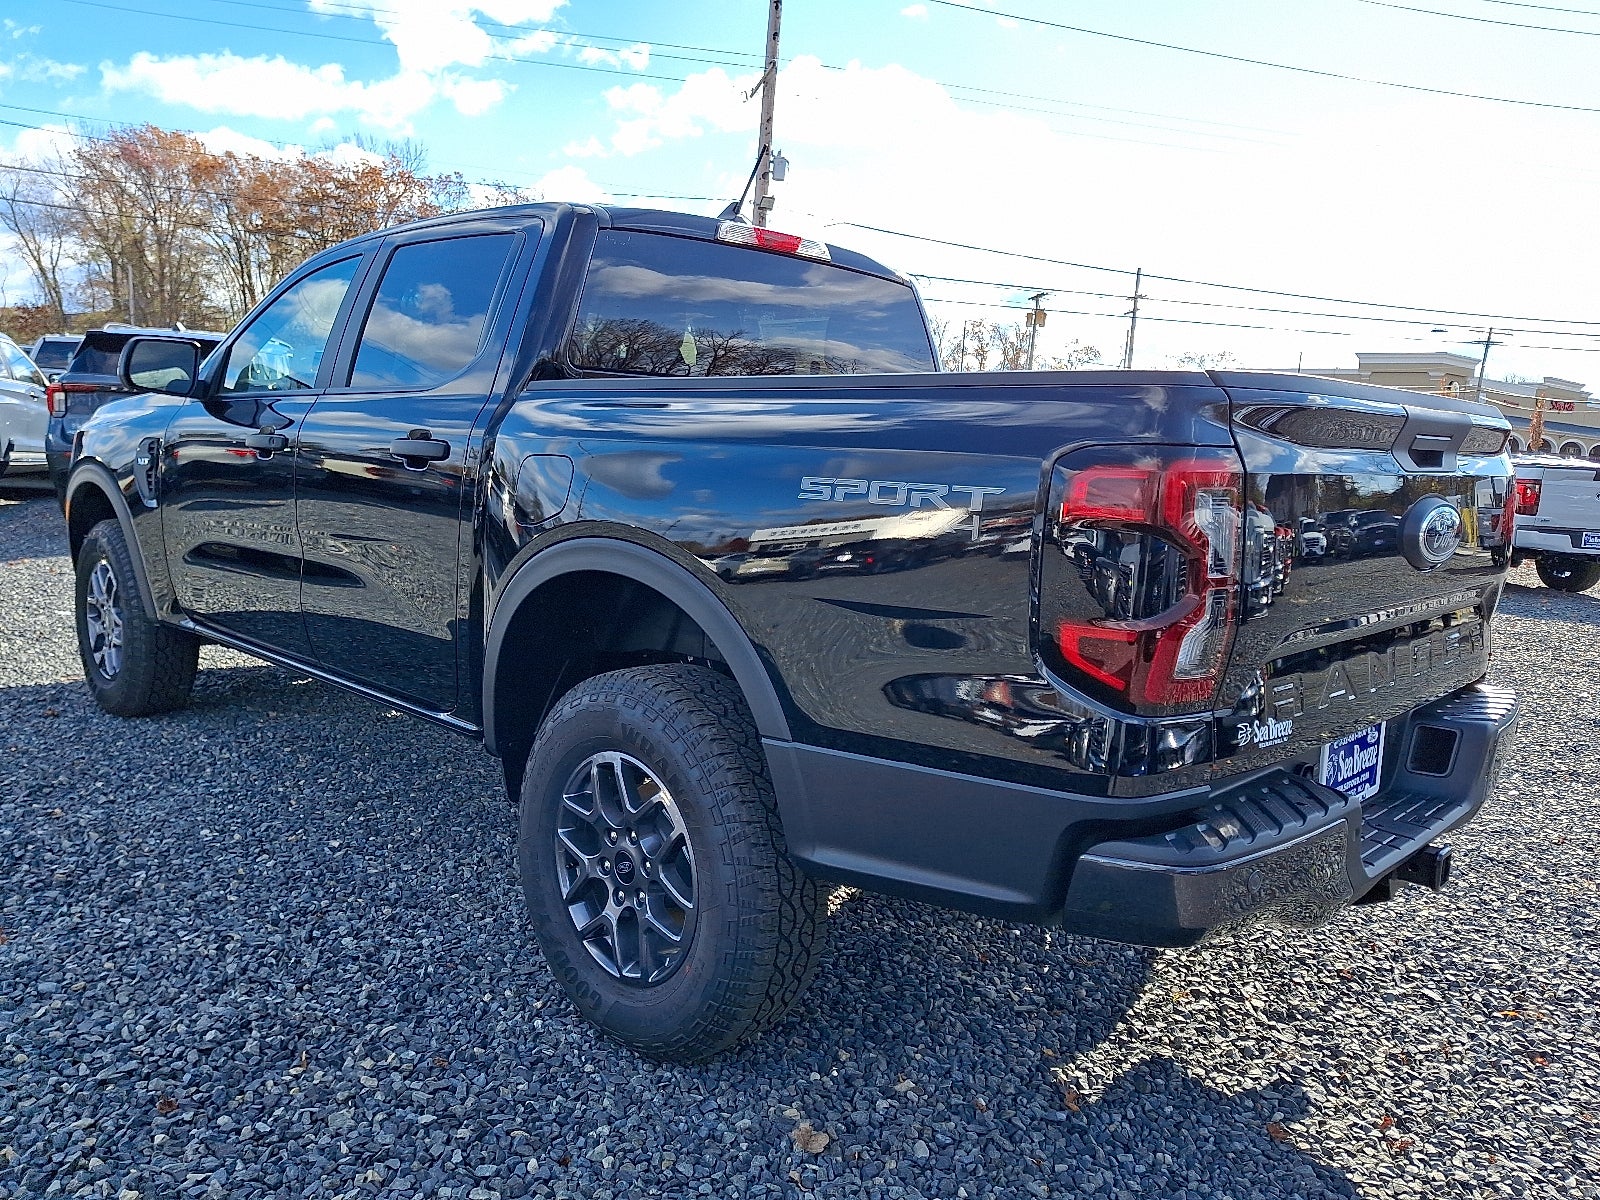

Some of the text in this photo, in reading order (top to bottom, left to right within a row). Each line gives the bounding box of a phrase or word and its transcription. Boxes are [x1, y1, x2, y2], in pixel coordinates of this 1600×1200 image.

[798, 476, 1006, 512] SPORT
[1253, 720, 1269, 744] Sea
[1267, 718, 1293, 740] Breeze
[1337, 744, 1378, 782] Sea Breeze
